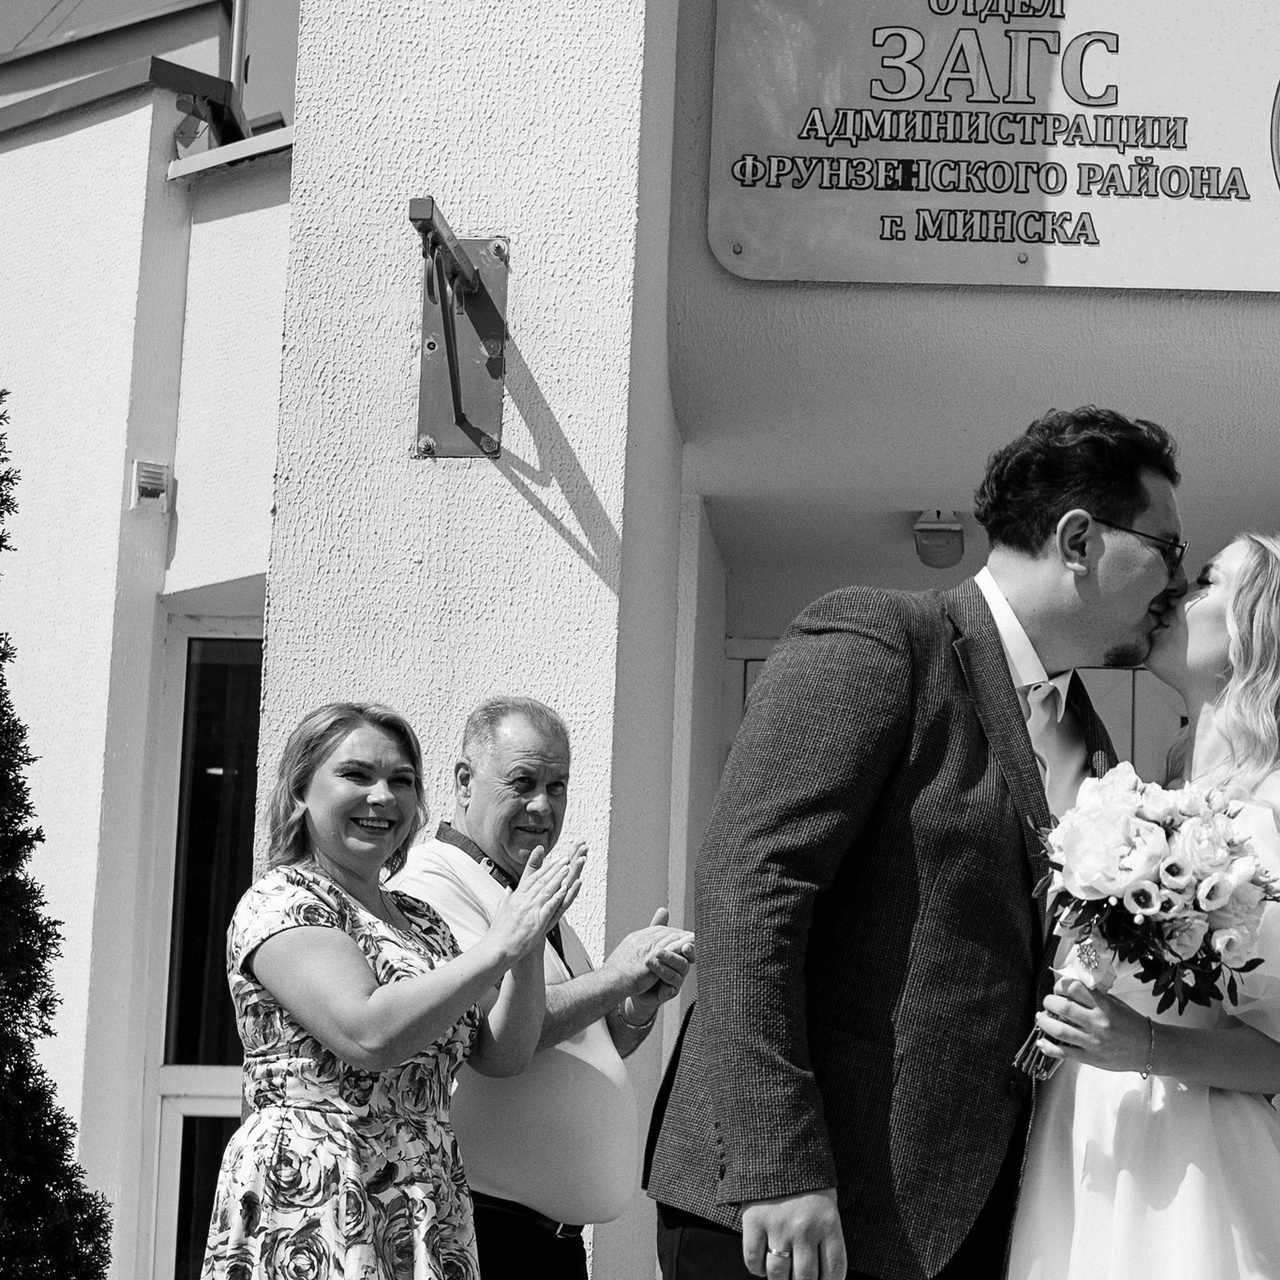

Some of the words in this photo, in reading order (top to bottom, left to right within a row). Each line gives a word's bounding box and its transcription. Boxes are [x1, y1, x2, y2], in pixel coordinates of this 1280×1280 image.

[870, 25, 1119, 107] ЗАГС
[798, 107, 1188, 154] АДМИНИСТРАЦИИ
[731, 154, 1067, 195] ФРУНЗЕНСКОГО
[1077, 156, 1250, 201] РАЙОНА
[880, 213, 908, 242] г.
[915, 209, 1101, 246] МИНСКА
